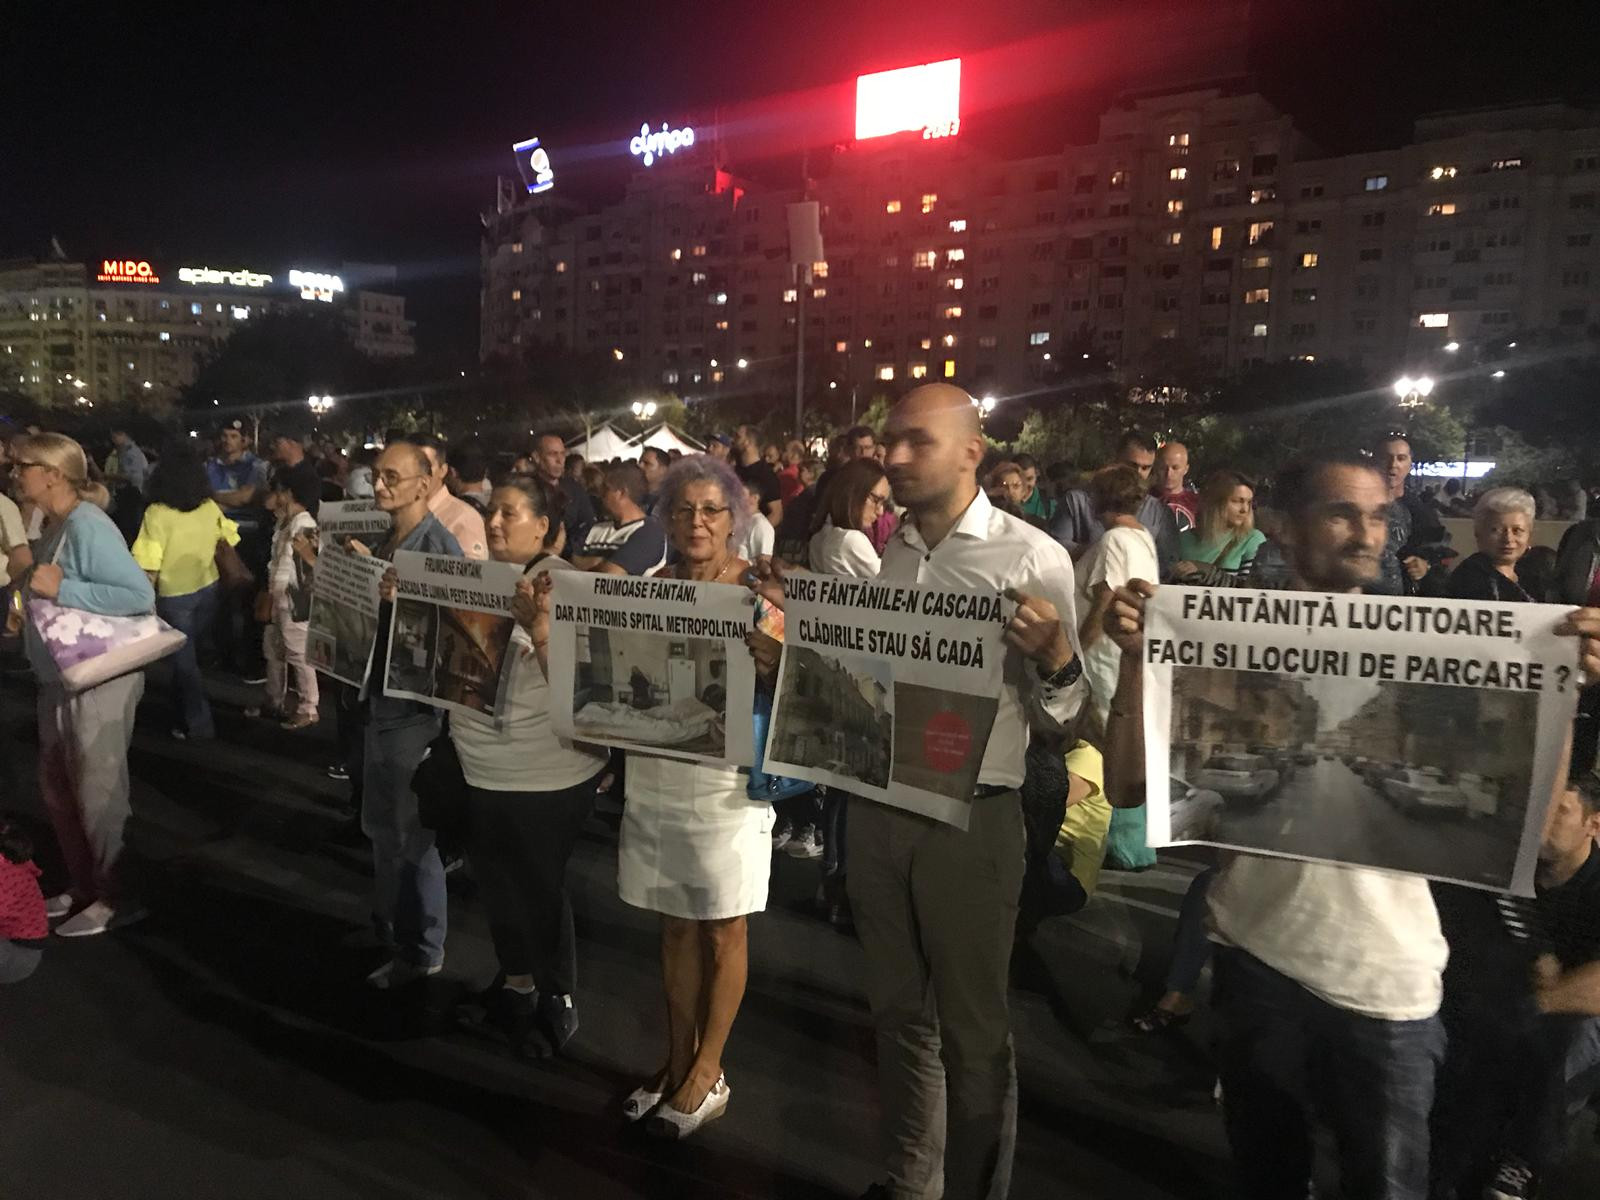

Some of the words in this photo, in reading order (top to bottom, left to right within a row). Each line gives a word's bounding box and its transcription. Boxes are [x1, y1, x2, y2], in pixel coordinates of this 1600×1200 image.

[104, 260, 151, 277] MIDO
[594, 577, 648, 600] FRUMOASE
[649, 579, 697, 606] FÂNTÂNI,
[819, 577, 920, 613] FÂNTÂNILE-N
[922, 592, 1008, 628] CASCADĂ,
[1182, 591, 1338, 635] FÂNTÂNIȚĂ
[1348, 603, 1522, 642] LUCITOARE,
[555, 604, 574, 621] DAR
[576, 607, 591, 624] ATI
[593, 608, 628, 628] PROMIS
[630, 612, 664, 632] SPITAL
[666, 616, 747, 640] METROPOLITAN
[799, 617, 864, 651] CLĂDIRILE
[868, 629, 906, 657] STAU
[911, 631, 931, 661] SĂ
[936, 637, 984, 669] CADĂ
[1147, 639, 1203, 666] FACI
[1212, 641, 1237, 668] SI
[1247, 644, 1348, 676] LOCURI
[1359, 652, 1395, 680] DE
[1405, 655, 1543, 691] PARCARE
[1554, 666, 1571, 693] ?
